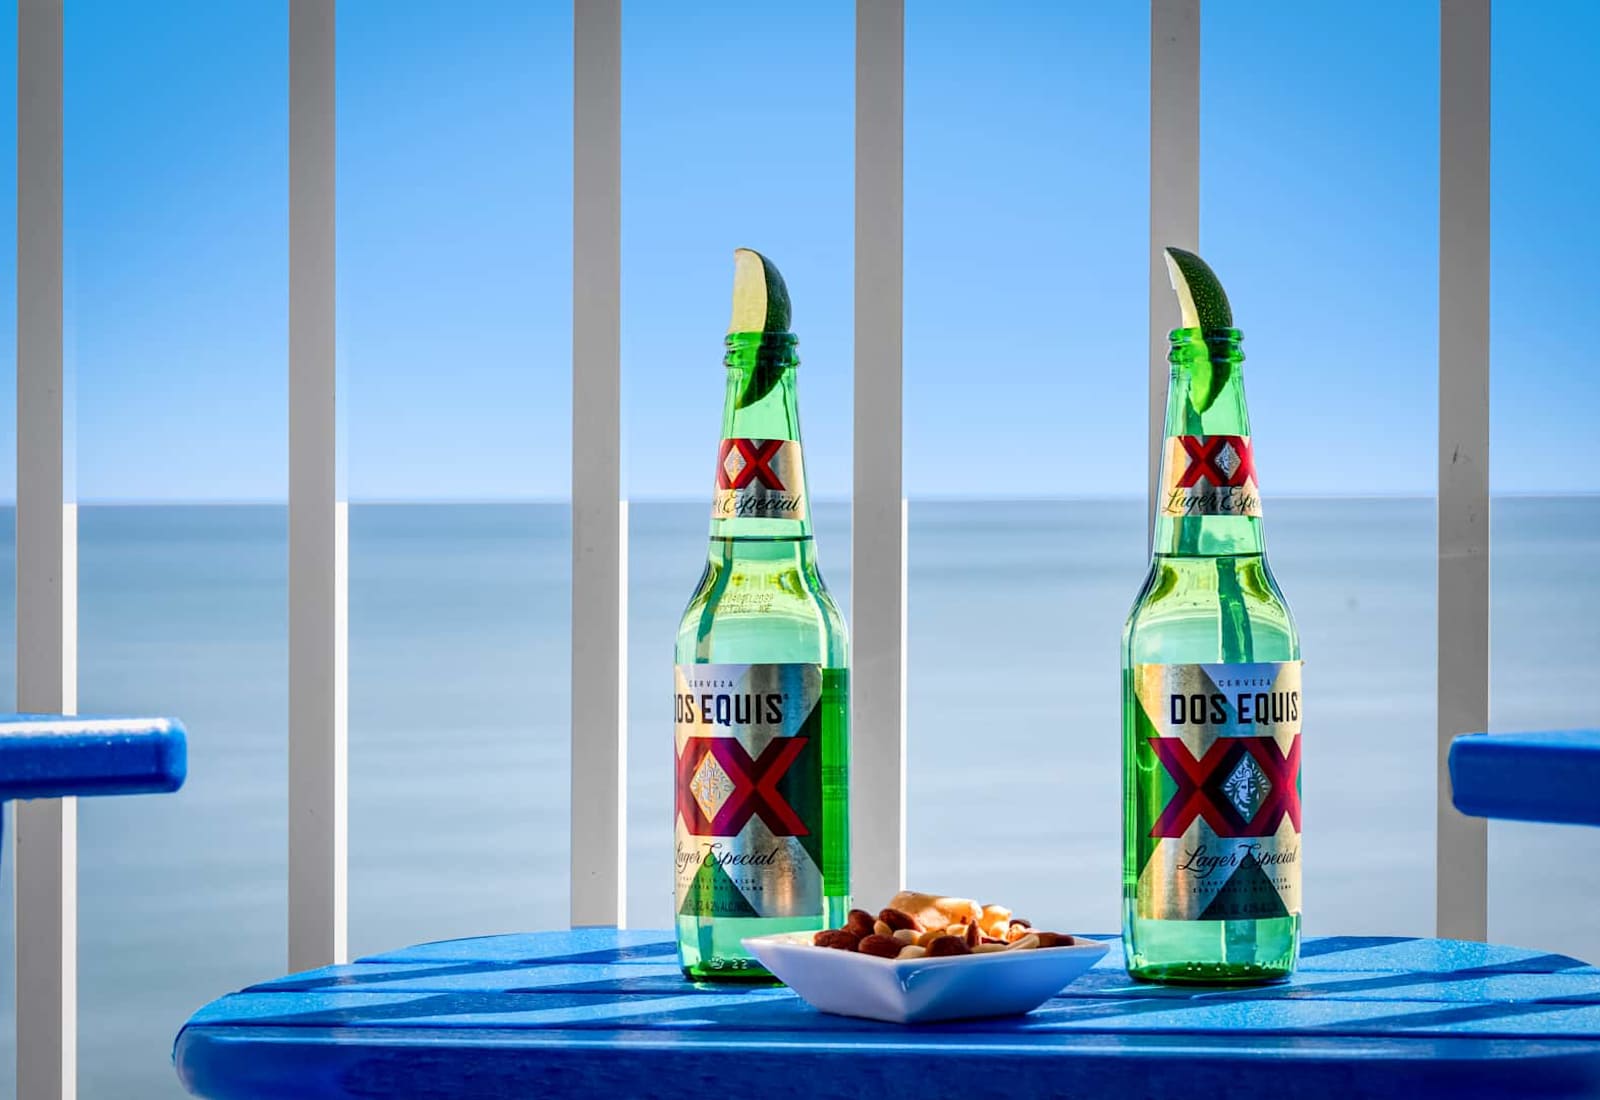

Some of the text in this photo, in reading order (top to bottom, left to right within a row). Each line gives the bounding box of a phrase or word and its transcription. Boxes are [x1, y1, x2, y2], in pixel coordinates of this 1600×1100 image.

[722, 490, 802, 517] Especial
[1162, 488, 1217, 515] Lager
[688, 679, 734, 688] CERVEZA
[1218, 679, 1271, 687] CERVEZA
[674, 694, 783, 727] OS EQUIS
[1170, 692, 1298, 726] DOS EQUIS
[1148, 734, 1302, 838] XX
[702, 842, 779, 872] Especial
[1177, 843, 1298, 879] Lager Especial
